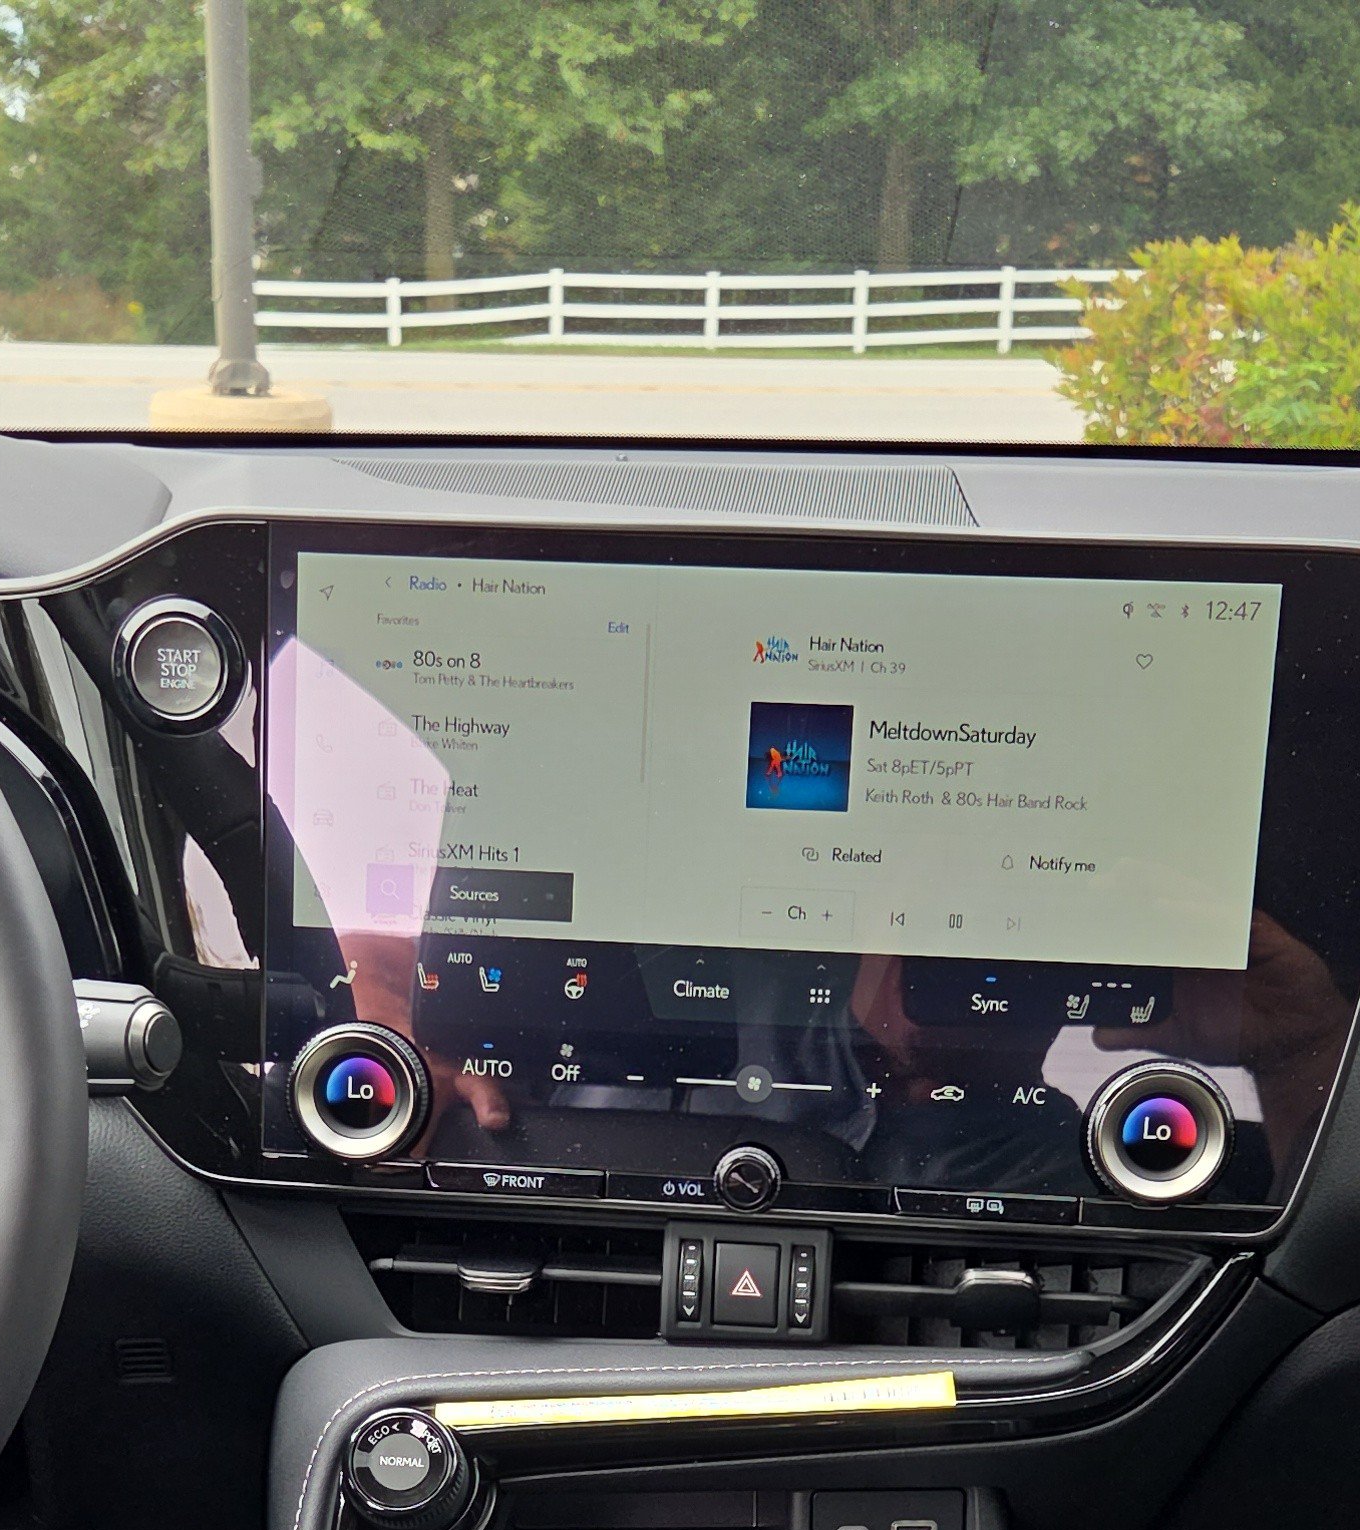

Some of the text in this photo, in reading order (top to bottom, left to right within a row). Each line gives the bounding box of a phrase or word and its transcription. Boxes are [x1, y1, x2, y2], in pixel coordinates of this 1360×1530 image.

[409, 575, 546, 595] Radio Hair Nation
[377, 613, 420, 627] Favorites
[1206, 600, 1262, 621] 12:47
[607, 620, 629, 634] Edit
[809, 635, 885, 654] Hair Nation
[156, 648, 201, 664] START
[413, 650, 442, 667] 80s
[447, 657, 465, 668] on
[469, 652, 481, 669] 8
[160, 664, 197, 677] STOP
[808, 658, 855, 673] SiriusXM
[870, 661, 886, 673] Ch
[890, 662, 907, 674] 39
[160, 678, 197, 690] ENGINE
[413, 672, 575, 690] Tom Petty & The Heartbreakers
[411, 714, 510, 738] The Highway
[869, 720, 1037, 749] MeltdownSaturday
[866, 758, 973, 778] Sat 8pET/5pPT
[410, 778, 479, 798] The Heat
[865, 787, 1088, 812] Keith Roth & 80s Hair Band Rock
[408, 842, 520, 863] SiriusXM Hits 1
[831, 847, 882, 864] Related
[1029, 855, 1096, 873] Notify me
[449, 885, 499, 902] Sources
[787, 905, 806, 921] Ch
[447, 952, 473, 965] AUTO
[566, 957, 588, 968] AUTO
[673, 979, 730, 1000] Climate
[971, 993, 1009, 1015] Sync
[462, 1058, 513, 1078] AUTO
[551, 1063, 582, 1082] Off
[347, 1075, 374, 1100] Lo
[1012, 1086, 1047, 1105] A/C
[1142, 1116, 1171, 1141] Lo
[501, 1174, 545, 1189] FRONT
[678, 1182, 705, 1197] VOL
[367, 1426, 391, 1446] ECO
[379, 1455, 425, 1468] NORMAL
